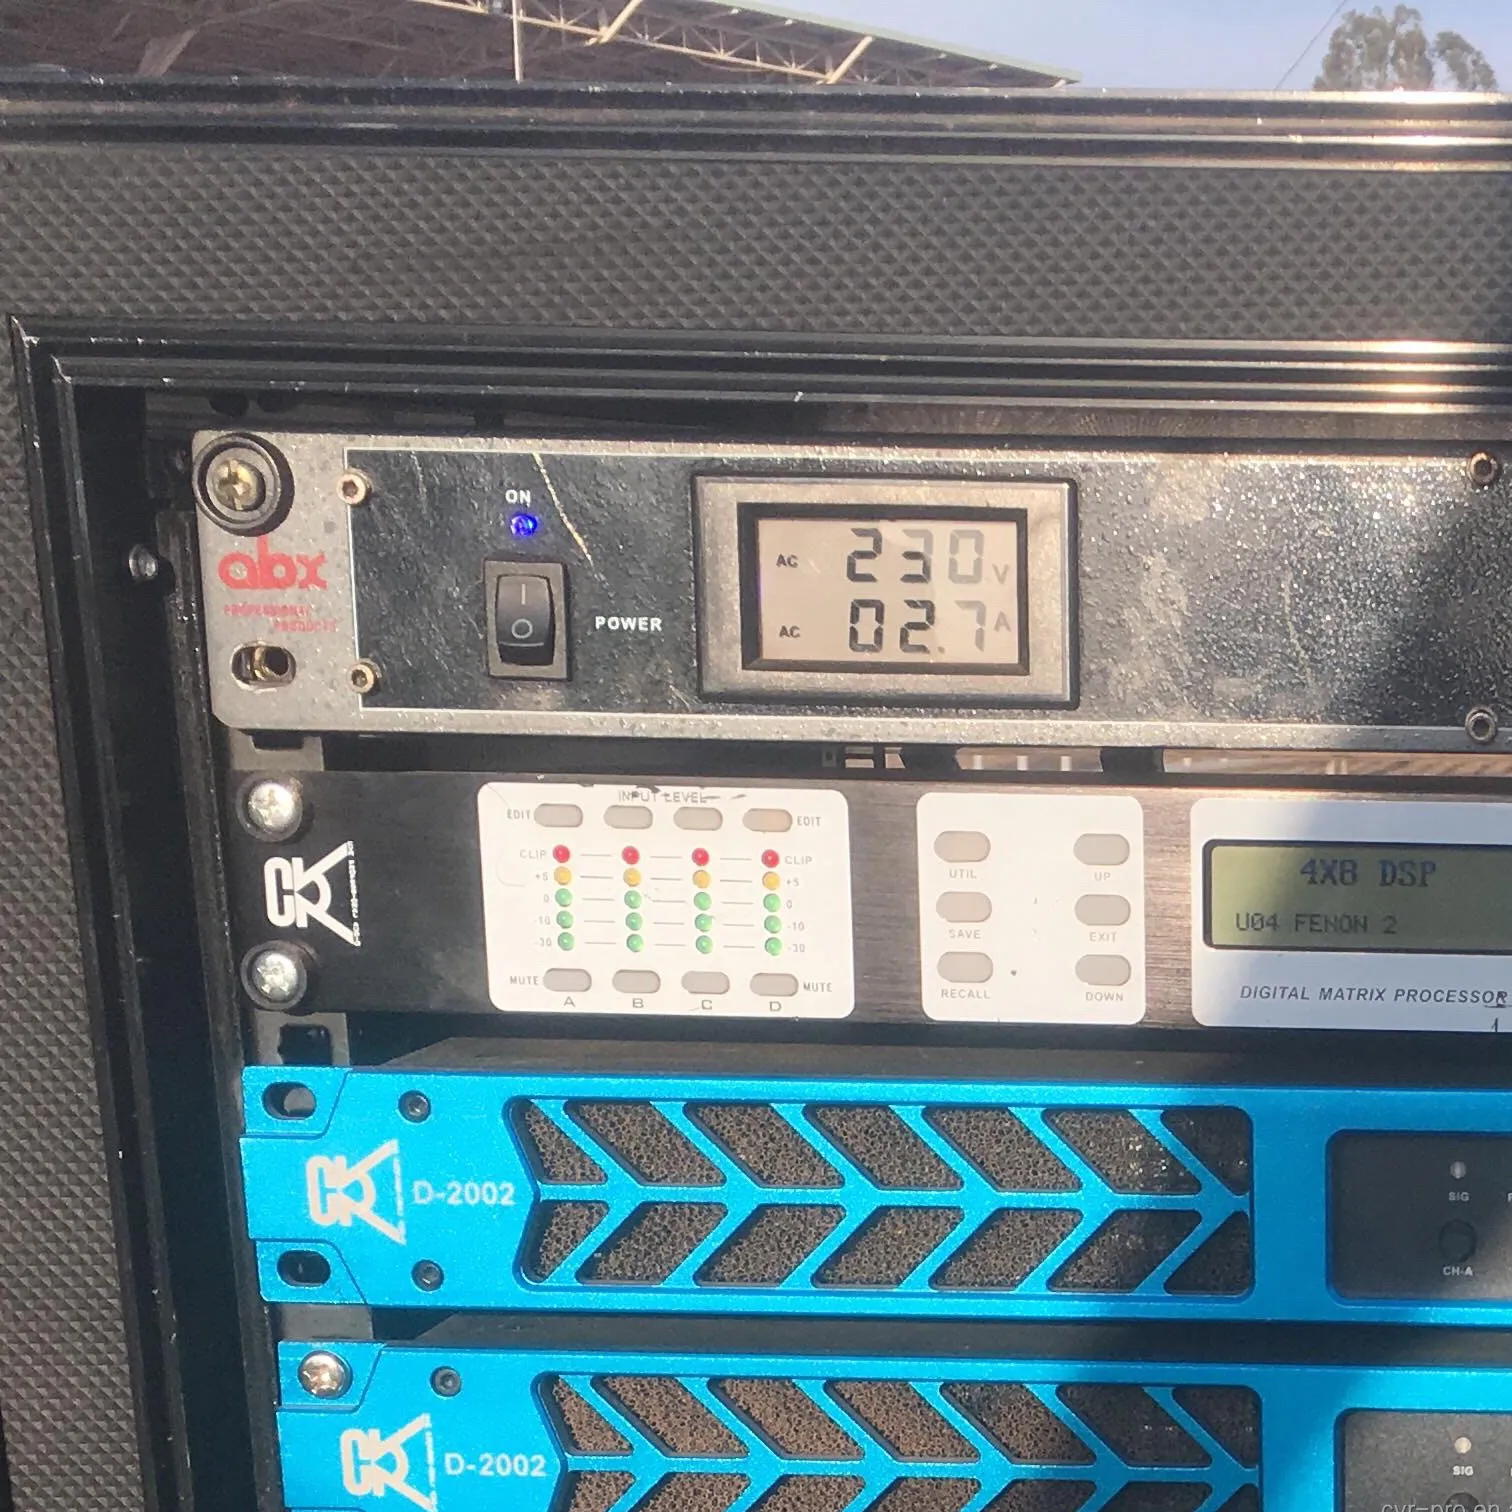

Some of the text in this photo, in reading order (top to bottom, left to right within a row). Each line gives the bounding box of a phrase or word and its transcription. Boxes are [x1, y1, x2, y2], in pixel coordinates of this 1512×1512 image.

[506, 489, 530, 504] ON
[776, 527, 1010, 584] AC 230 V
[595, 616, 662, 632] POWER
[779, 599, 1011, 654] AC 02.7 A
[664, 791, 709, 804] LEVEL
[507, 809, 531, 820] EDIT
[797, 816, 822, 827] EDIT
[519, 849, 546, 860] CLIP
[785, 855, 812, 866] CLIP
[949, 869, 977, 879] UTIL
[1094, 872, 1111, 882] UP
[1379, 860, 1436, 887] DSP
[1383, 915, 1398, 934] 2
[949, 929, 982, 940] SAVE
[1089, 932, 1118, 943] EXIT
[510, 976, 539, 986] MUTE
[803, 982, 833, 993] MUTE
[941, 989, 991, 1000] RECALL
[1085, 992, 1124, 1002] DOWN
[1240, 985, 1508, 1004] DIGITAL MATRIX PROCESSOR
[563, 996, 576, 1008] A
[632, 998, 644, 1009] B
[702, 1000, 713, 1011] C
[769, 1001, 782, 1012] D
[412, 1180, 516, 1206] D-2002
[1448, 1191, 1469, 1202] SIG
[444, 1453, 546, 1477] D-2002
[1452, 1466, 1474, 1477] SIG
